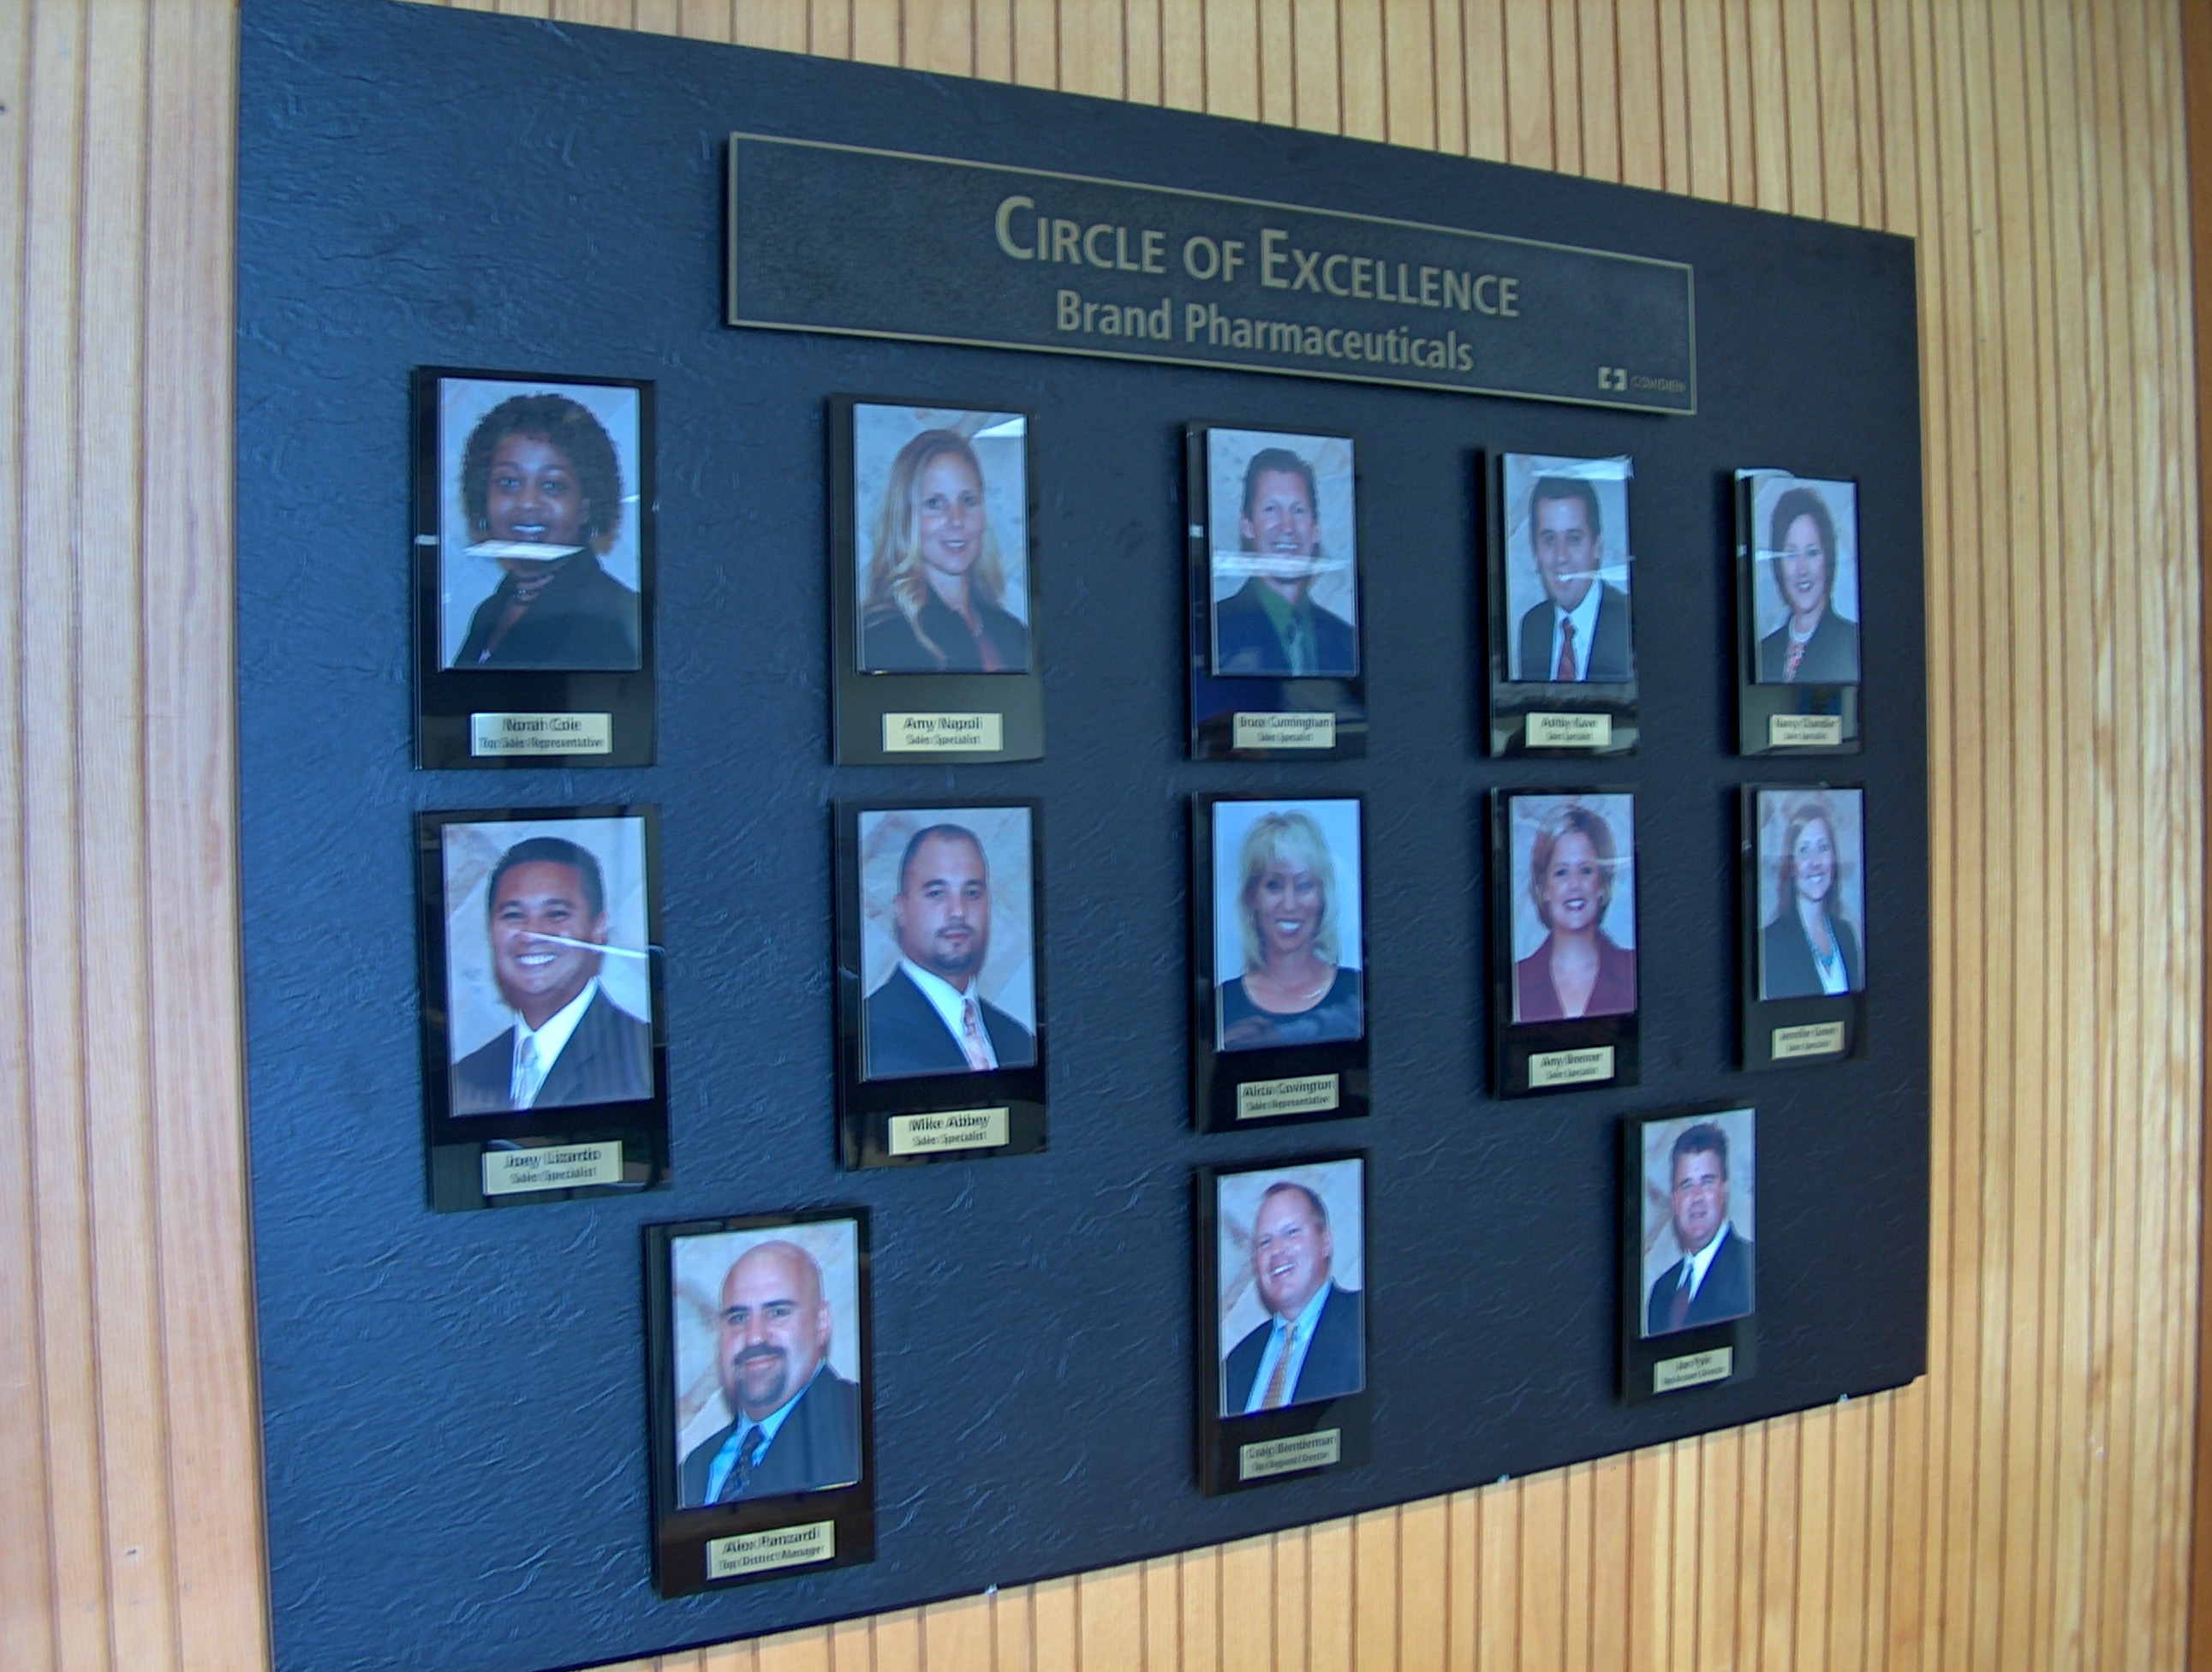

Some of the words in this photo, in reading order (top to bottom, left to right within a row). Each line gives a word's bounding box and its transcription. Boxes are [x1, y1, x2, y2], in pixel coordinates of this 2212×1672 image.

[995, 195, 1166, 274] CIRCLE
[1261, 228, 1520, 317] EXCELLENCE
[1057, 290, 1172, 339] Brand
[1185, 302, 1475, 372] Pharmaceuticals
[903, 717, 935, 732] Amy
[938, 717, 983, 732] Napoli
[906, 735, 931, 745] Sales
[933, 735, 981, 747] Specialist
[909, 1117, 944, 1132] Mike
[945, 1114, 991, 1130] Abbey
